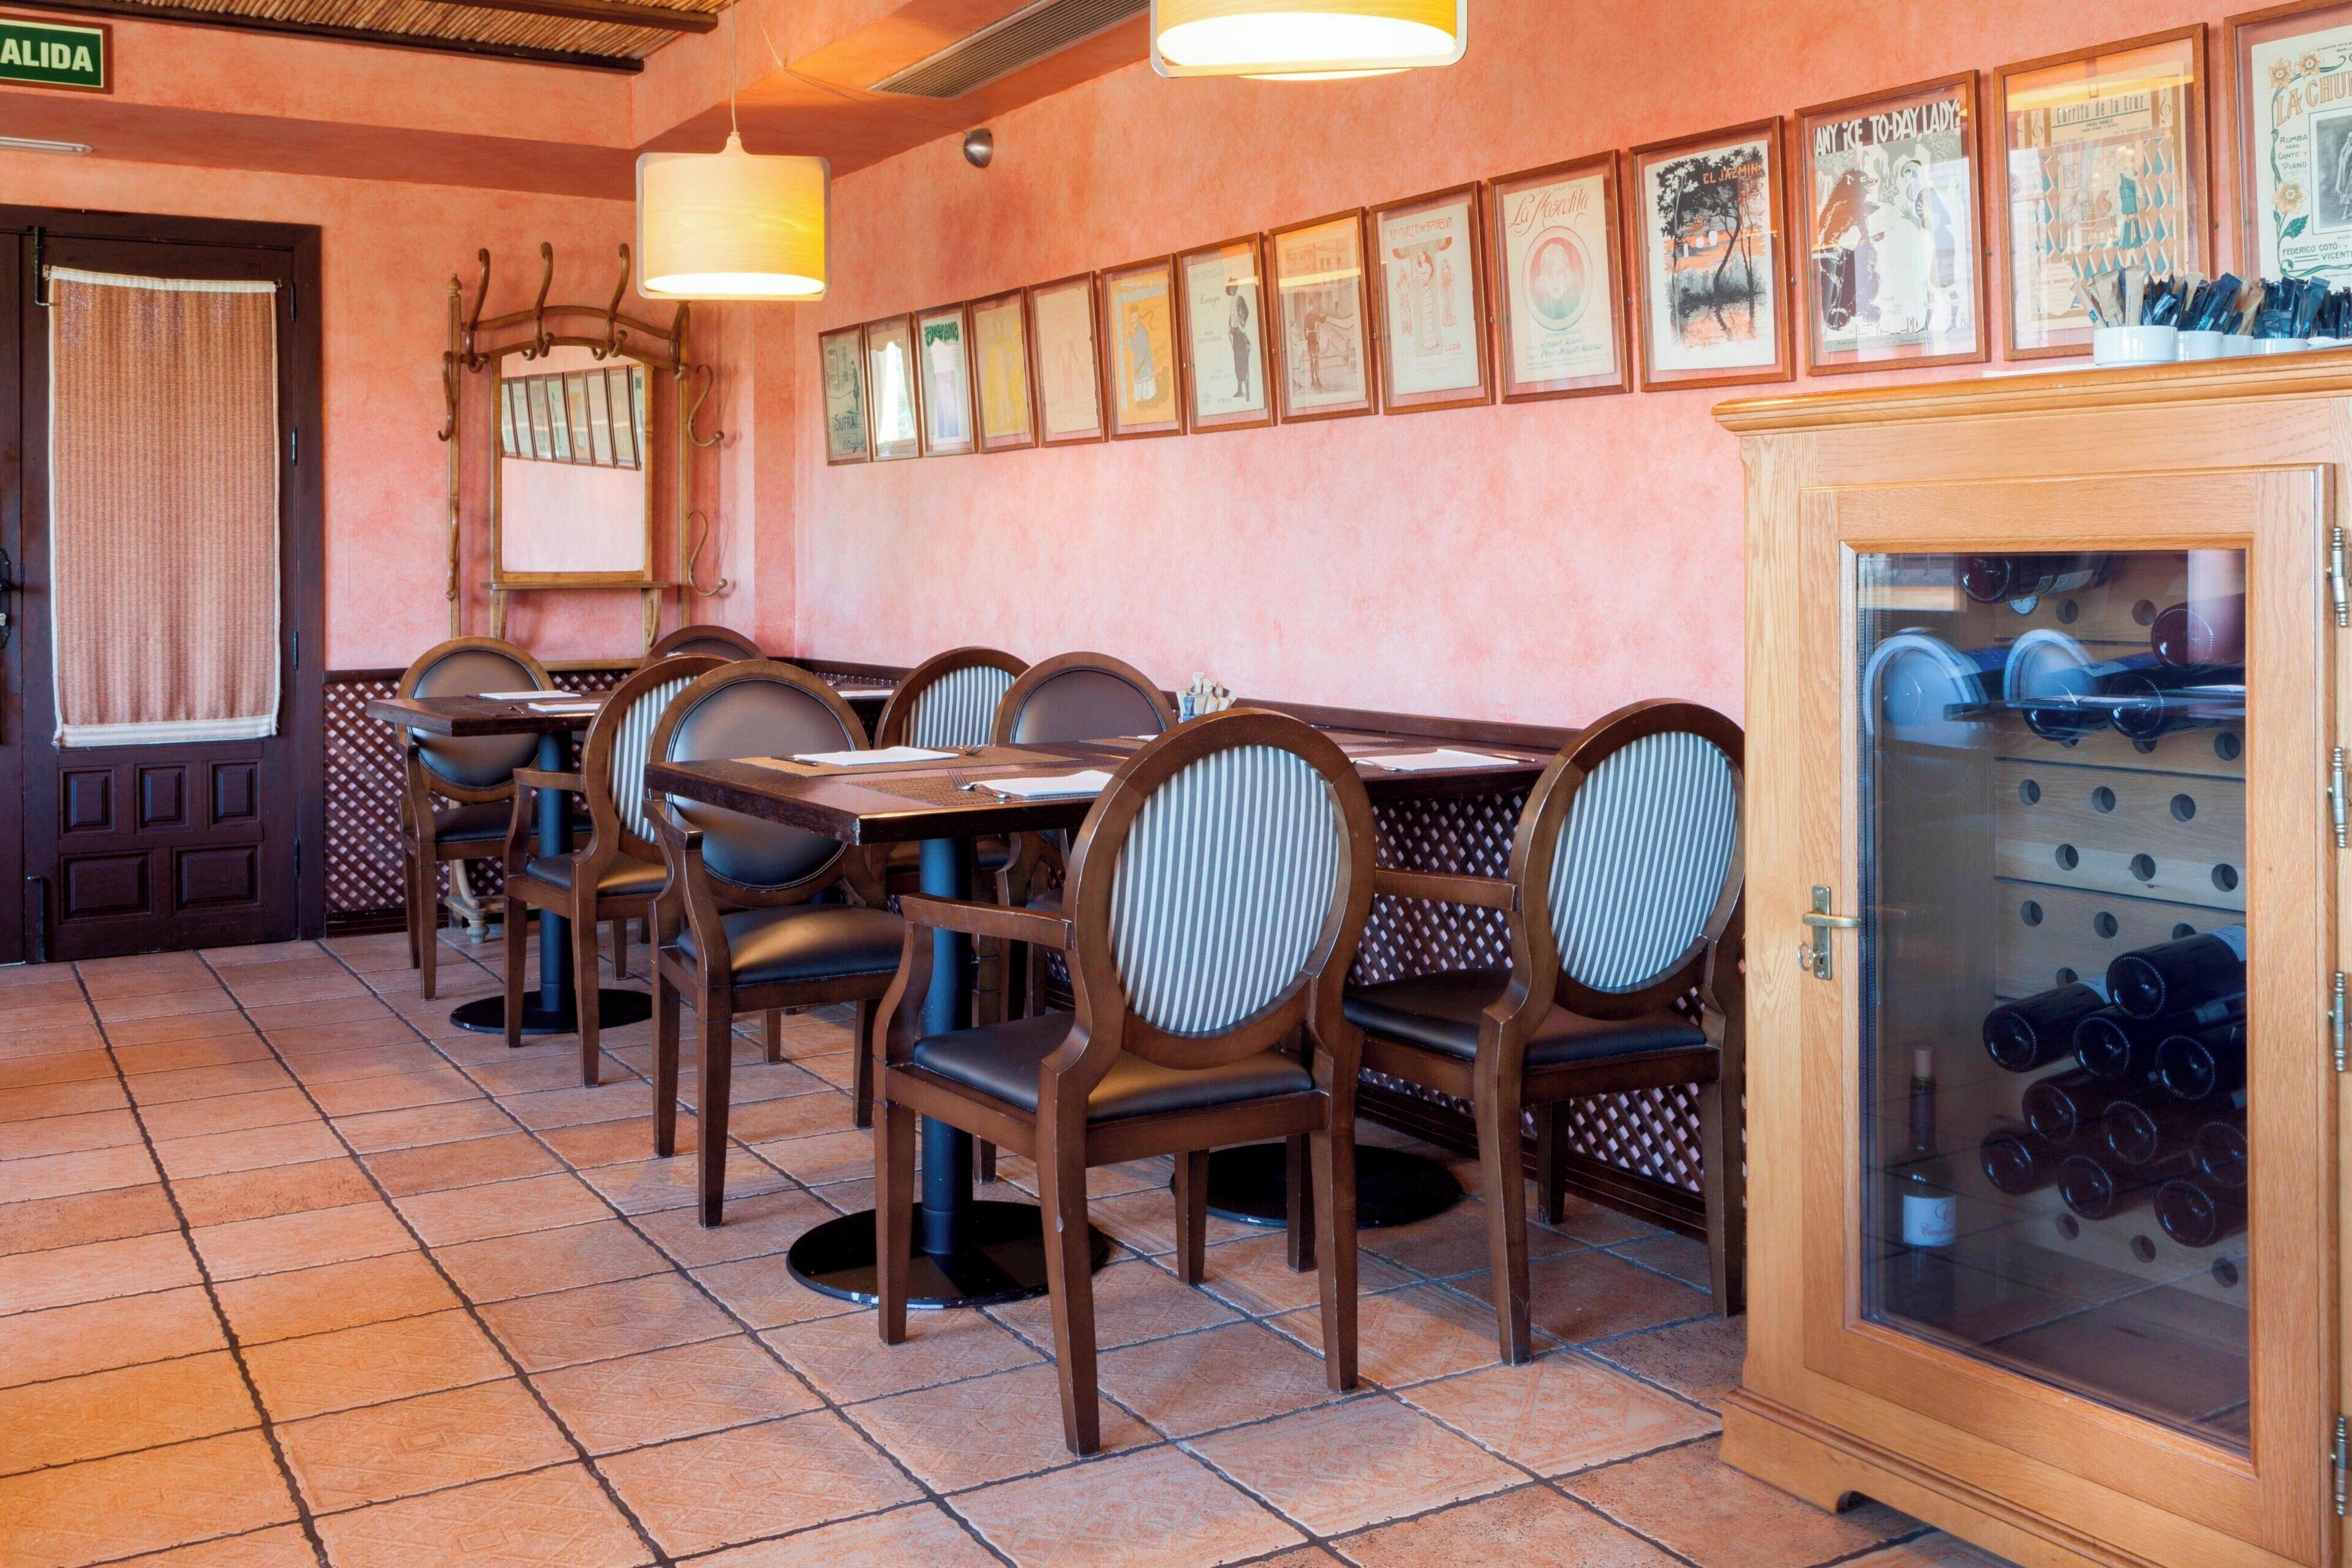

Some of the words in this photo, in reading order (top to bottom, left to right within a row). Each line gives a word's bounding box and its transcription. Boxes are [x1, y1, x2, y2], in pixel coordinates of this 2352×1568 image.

[0, 39, 94, 72] ALIDA
[2095, 101, 2105, 117] de
[2111, 99, 2119, 114] la
[2124, 95, 2144, 111] Cruz
[2277, 88, 2303, 126] LA
[1815, 123, 1838, 157] ANY
[2280, 134, 2308, 143] RUMBA
[1703, 172, 1716, 184] EL
[1509, 194, 1536, 229] La
[2283, 246, 2315, 255] FEDERICO
